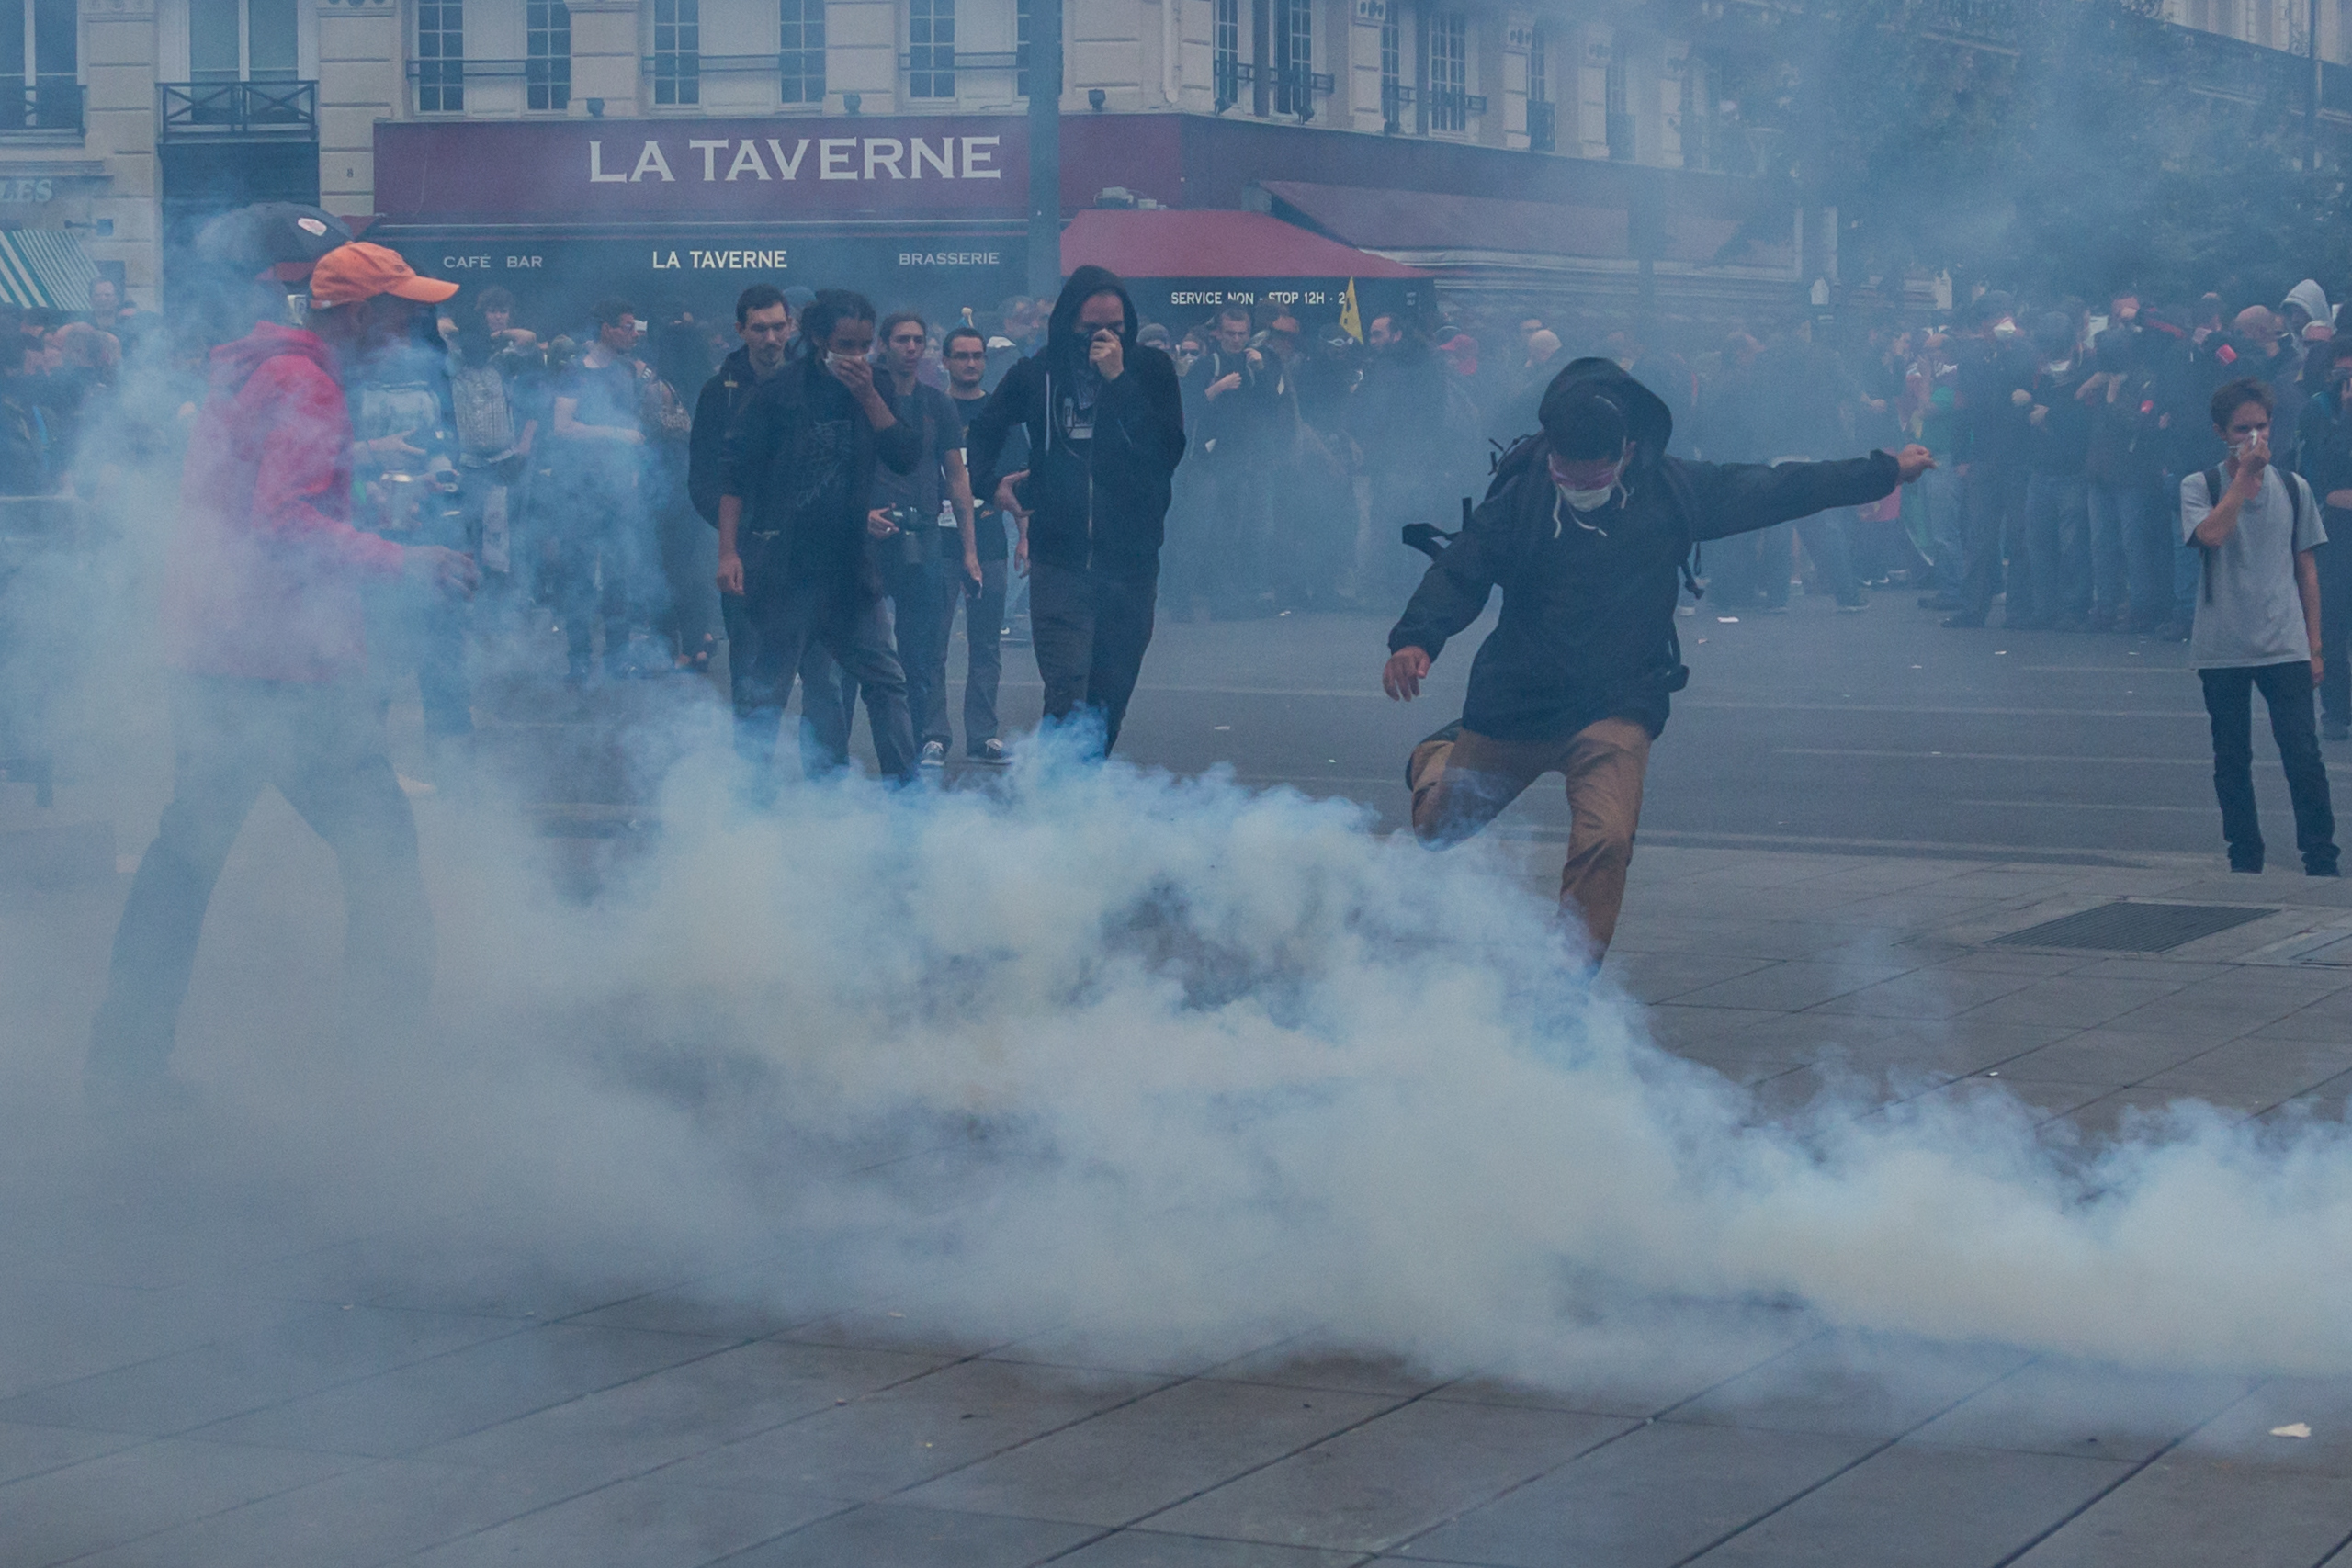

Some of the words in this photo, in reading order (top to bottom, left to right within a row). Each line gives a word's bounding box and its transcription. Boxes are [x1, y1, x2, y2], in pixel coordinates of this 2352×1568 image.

[589, 140, 675, 184] LA
[689, 135, 1001, 182] TAVERNE
[443, 253, 492, 269] CAFÉ
[506, 255, 543, 269] BAR
[652, 250, 681, 269] LA
[689, 250, 788, 269] TAVERNE
[899, 252, 1001, 265] BRASSERIE
[1170, 291, 1223, 305] SERVICE
[1227, 291, 1254, 305] NON
[1268, 291, 1299, 305] STOP
[1304, 291, 1325, 305] 12H
